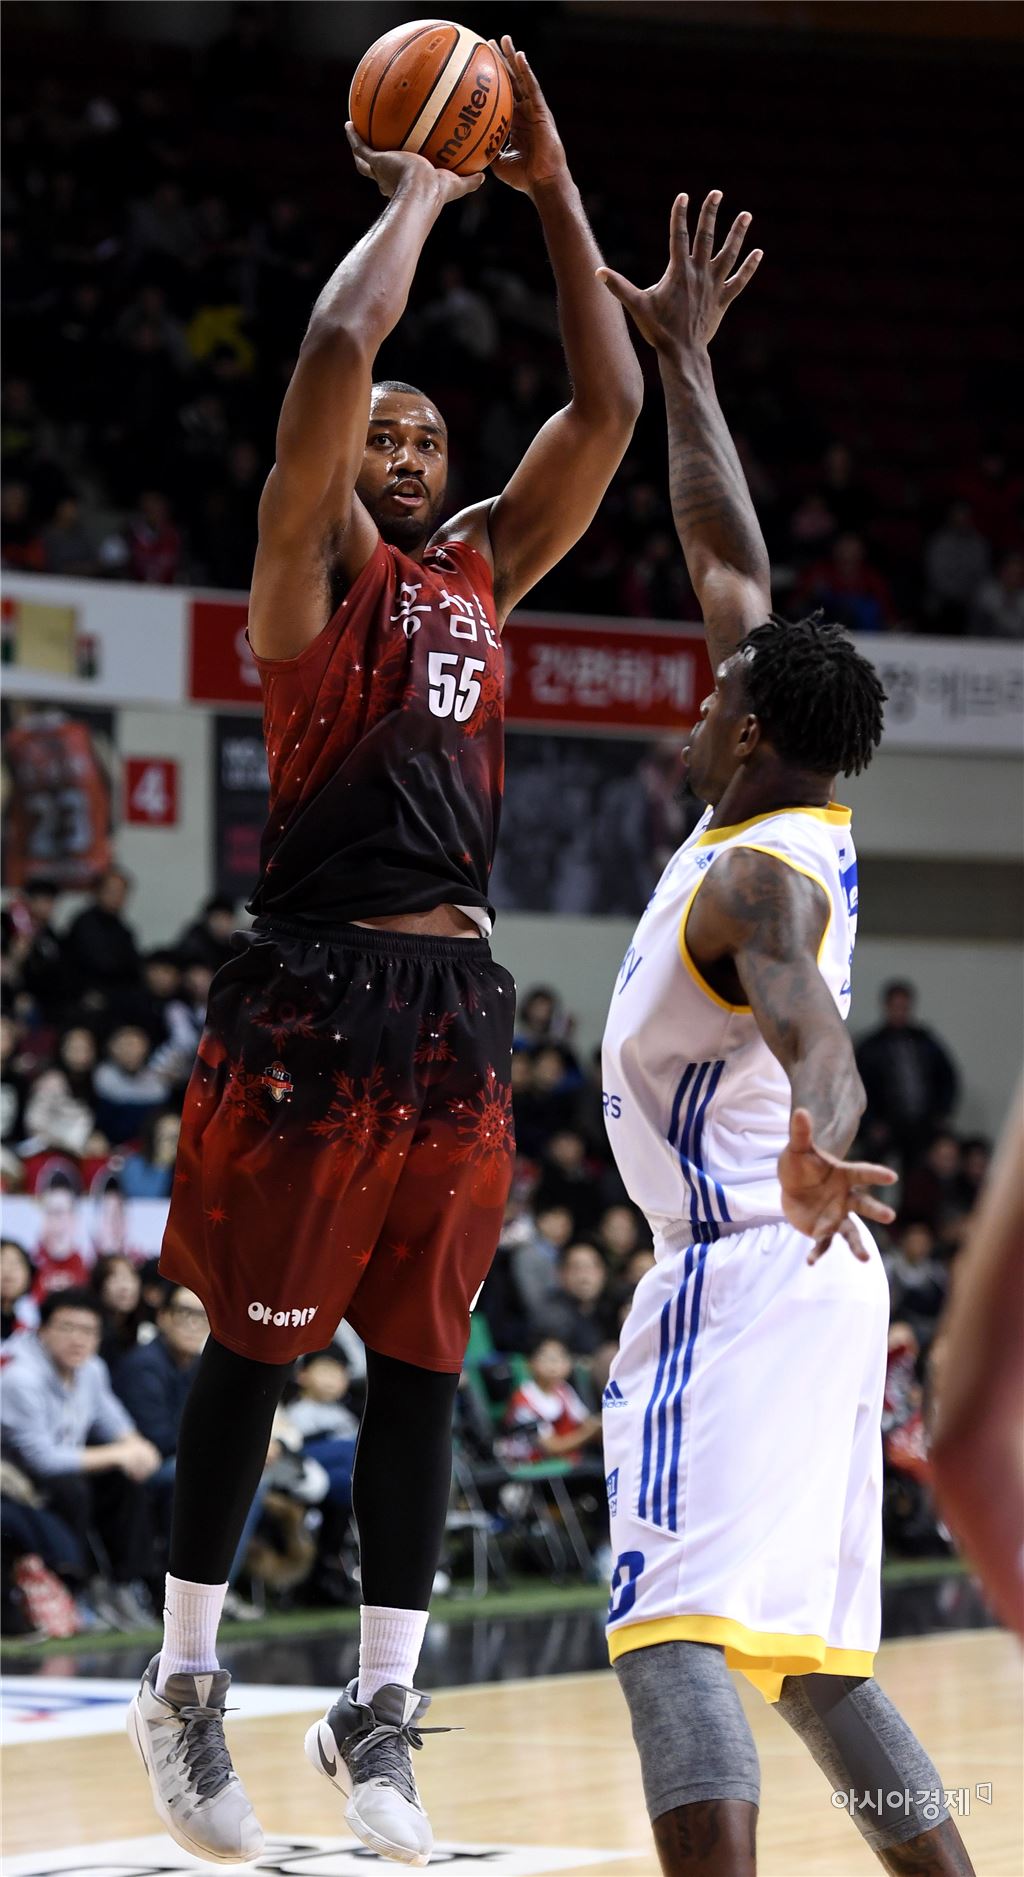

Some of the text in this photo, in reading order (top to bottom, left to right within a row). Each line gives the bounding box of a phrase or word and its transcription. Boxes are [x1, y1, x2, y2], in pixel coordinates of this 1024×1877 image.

[436, 73, 491, 163] molten
[427, 650, 487, 723] 55
[132, 766, 170, 819] 4
